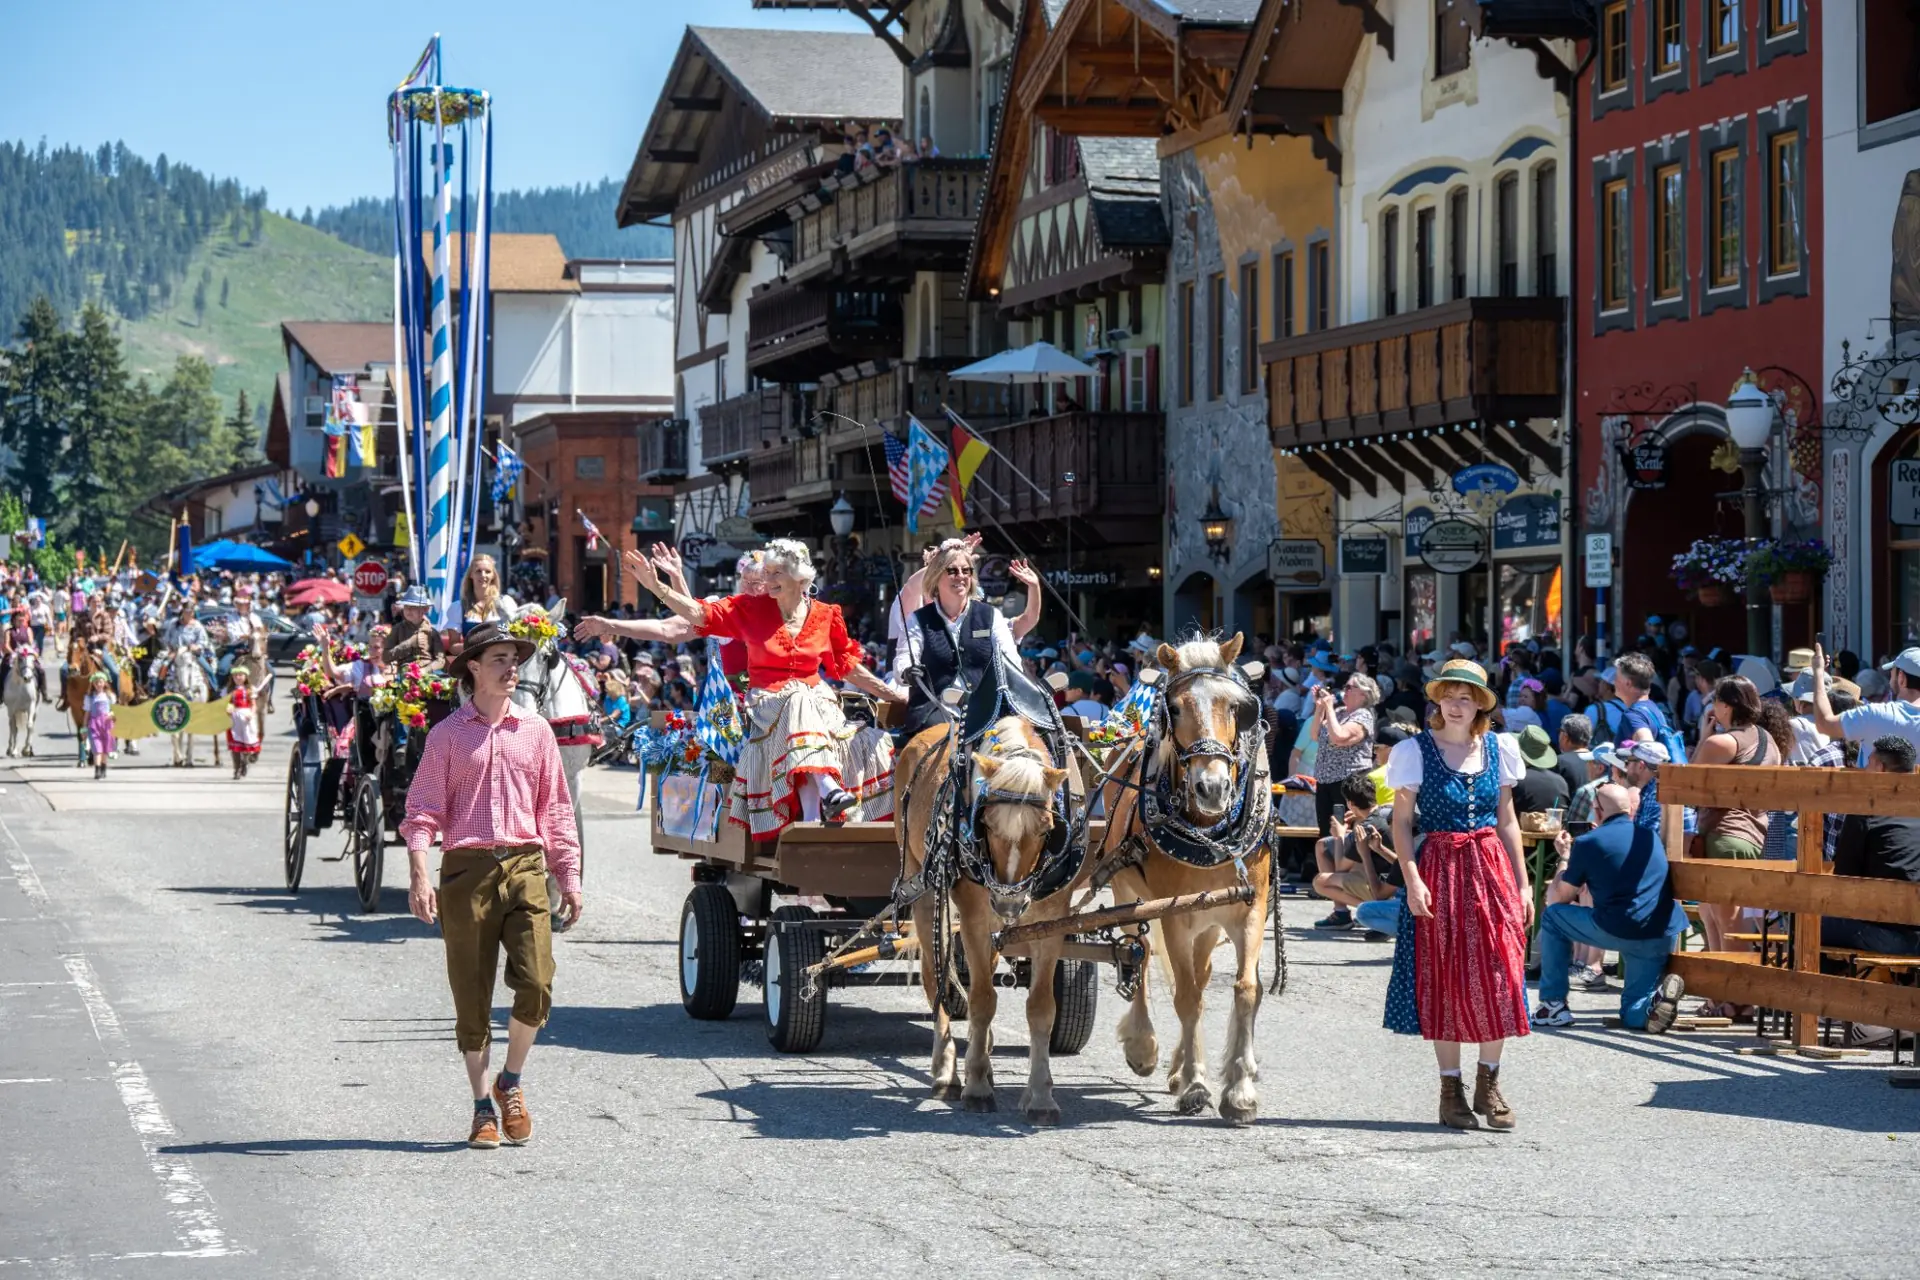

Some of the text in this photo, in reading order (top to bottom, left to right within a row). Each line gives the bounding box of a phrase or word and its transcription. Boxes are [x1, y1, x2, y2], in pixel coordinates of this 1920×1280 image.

[1635, 457, 1665, 469] Kettle
[1592, 538, 1606, 551] 30
[1277, 556, 1314, 568] Modern
[355, 571, 386, 587] STOP
[1055, 570, 1109, 586] Mozart's
